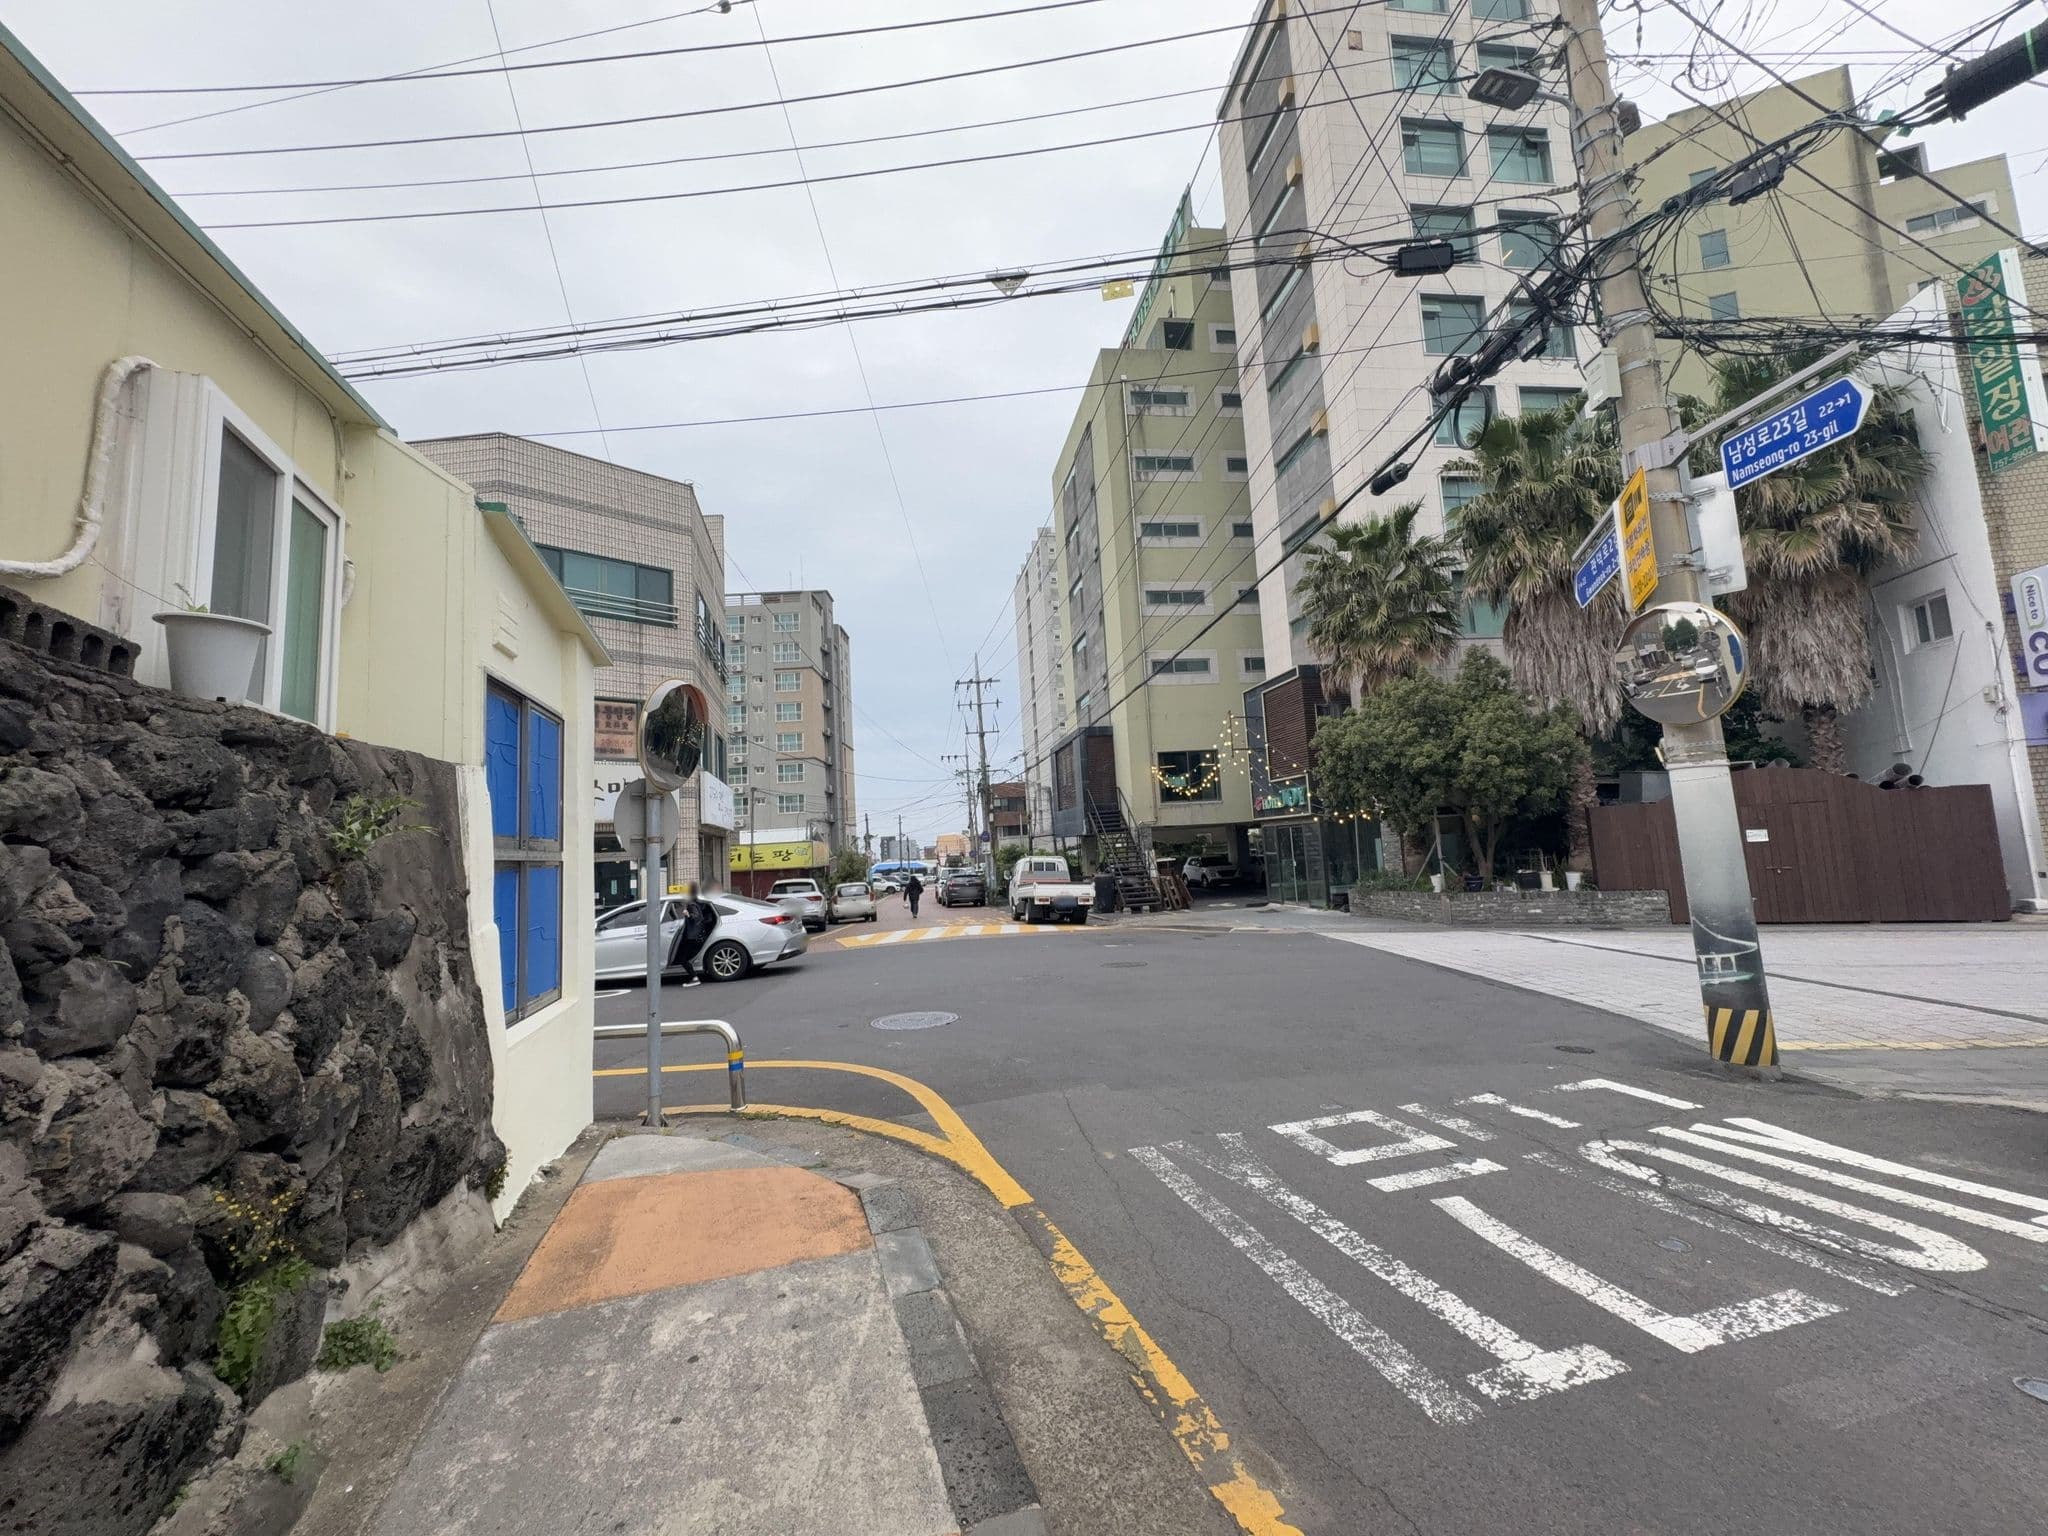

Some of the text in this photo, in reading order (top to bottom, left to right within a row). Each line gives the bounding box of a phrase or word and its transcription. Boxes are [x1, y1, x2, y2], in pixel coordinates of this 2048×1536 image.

[1728, 406, 1808, 465] 남성로23길
[1731, 419, 1840, 483] Namseong-ro 23-gil
[1986, 417, 2032, 454] 여관
[2025, 584, 2036, 607] Nice
[2030, 609, 2039, 620] to
